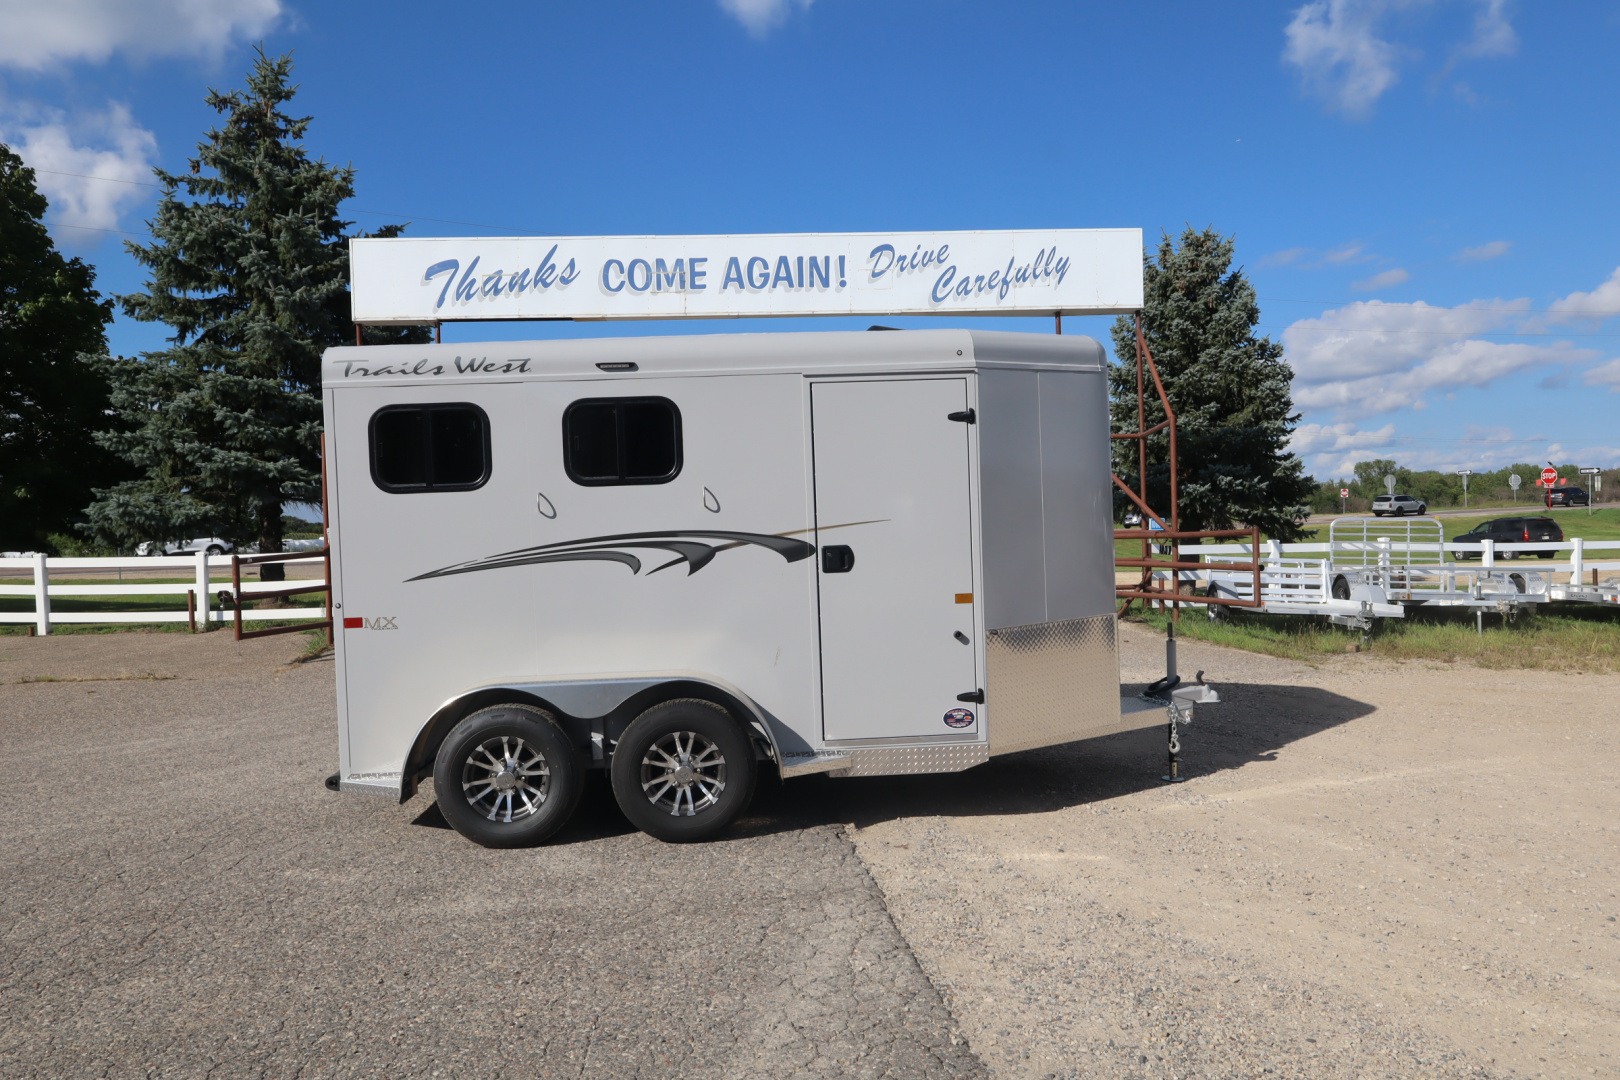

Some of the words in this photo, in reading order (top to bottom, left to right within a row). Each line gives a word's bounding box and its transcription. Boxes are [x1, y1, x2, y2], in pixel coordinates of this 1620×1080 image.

[424, 243, 581, 309] Thanks
[602, 257, 708, 293] COME
[722, 255, 847, 290] AGAIN!
[869, 243, 950, 279] Drive
[931, 244, 1071, 303] Carefully
[332, 358, 445, 378] Trails
[453, 355, 531, 374] West
[364, 616, 398, 630] MX
